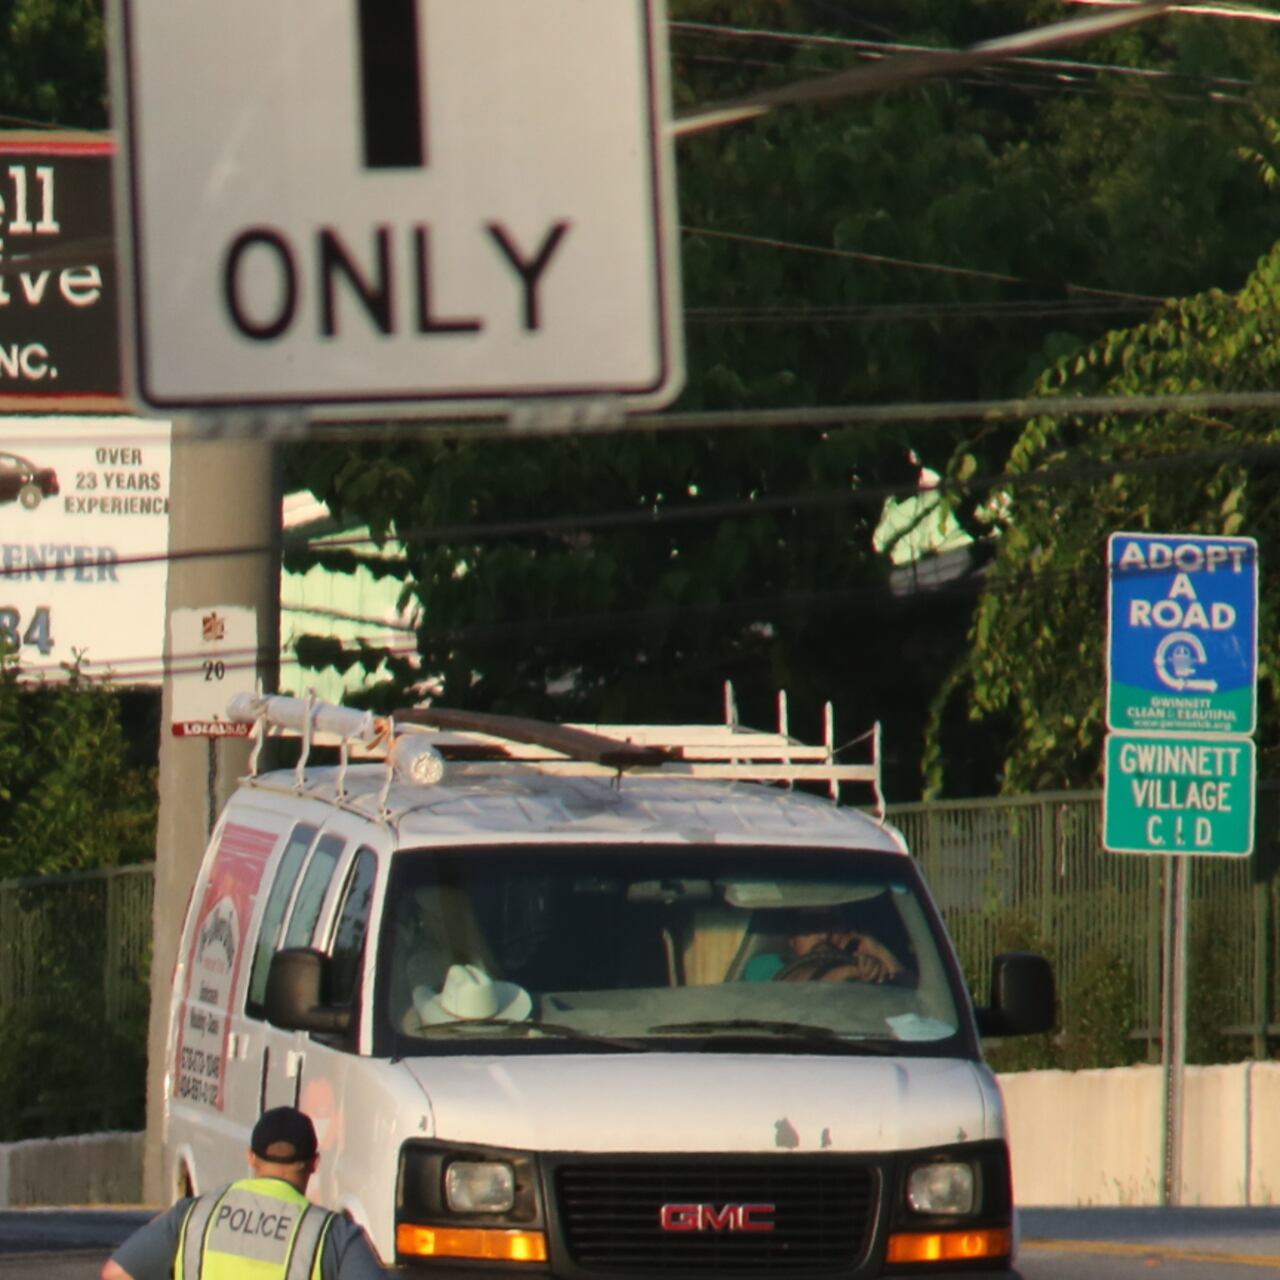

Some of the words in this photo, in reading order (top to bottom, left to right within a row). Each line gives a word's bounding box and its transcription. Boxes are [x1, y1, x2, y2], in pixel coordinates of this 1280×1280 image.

[221, 220, 573, 341] ONLY
[95, 447, 143, 465] OVER
[75, 471, 98, 490] 23
[103, 471, 160, 491] YEARS
[1119, 541, 1248, 574] ADOPT
[1168, 572, 1198, 600] A
[1129, 598, 1237, 630] ROAD
[202, 660, 225, 682] 20
[1119, 742, 1242, 778] GWINNETT
[1131, 778, 1232, 813] VILLAGE
[215, 1204, 292, 1241] POLICE
[660, 1203, 776, 1232] GMC
